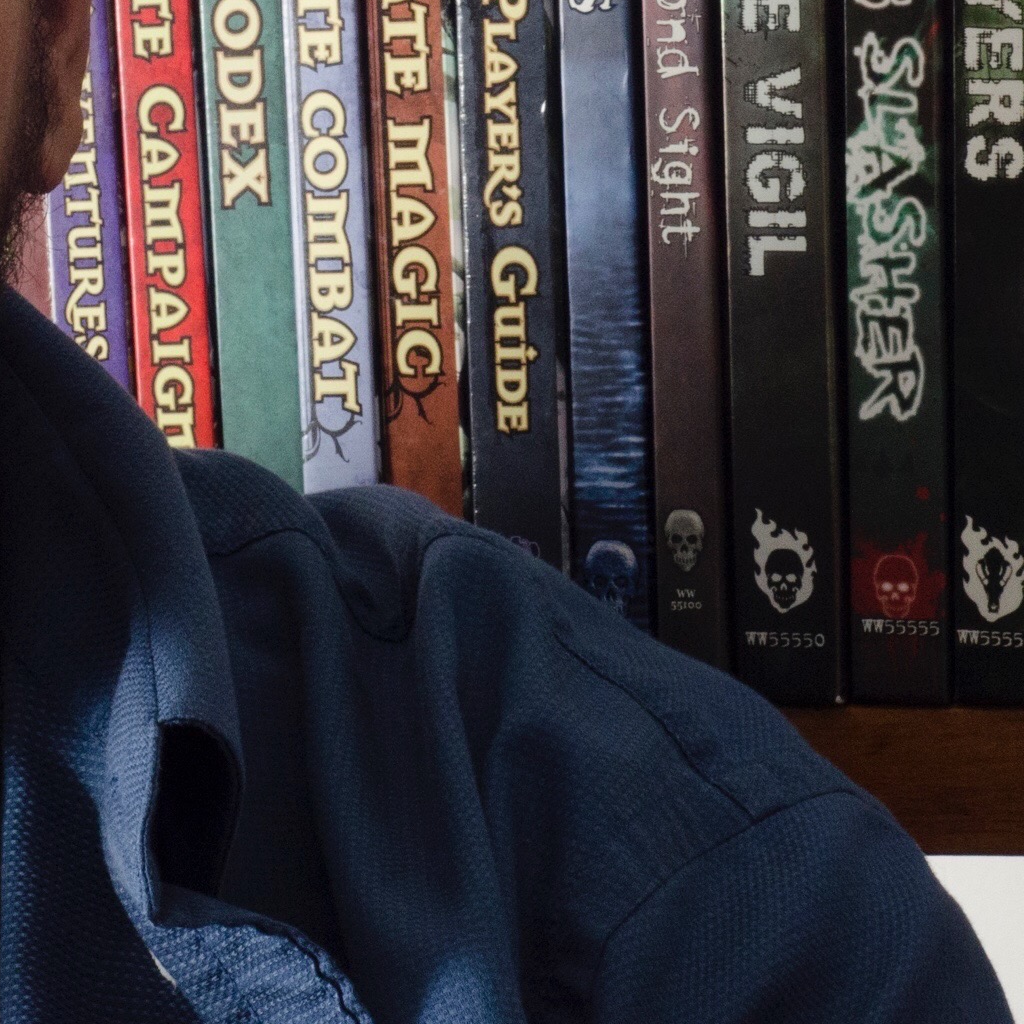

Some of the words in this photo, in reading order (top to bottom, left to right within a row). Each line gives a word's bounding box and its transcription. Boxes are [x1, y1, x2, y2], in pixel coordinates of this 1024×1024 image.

[300, 90, 363, 416] COMBAT
[387, 116, 444, 378] MAGIC
[651, 106, 701, 246] Sight
[742, 66, 807, 277] VIGIL
[846, 30, 926, 422] SLASHER
[490, 245, 540, 434] GUIDE
[676, 588, 696, 599] WW
[745, 631, 825, 648] WW55550
[861, 618, 940, 636] WW55555
